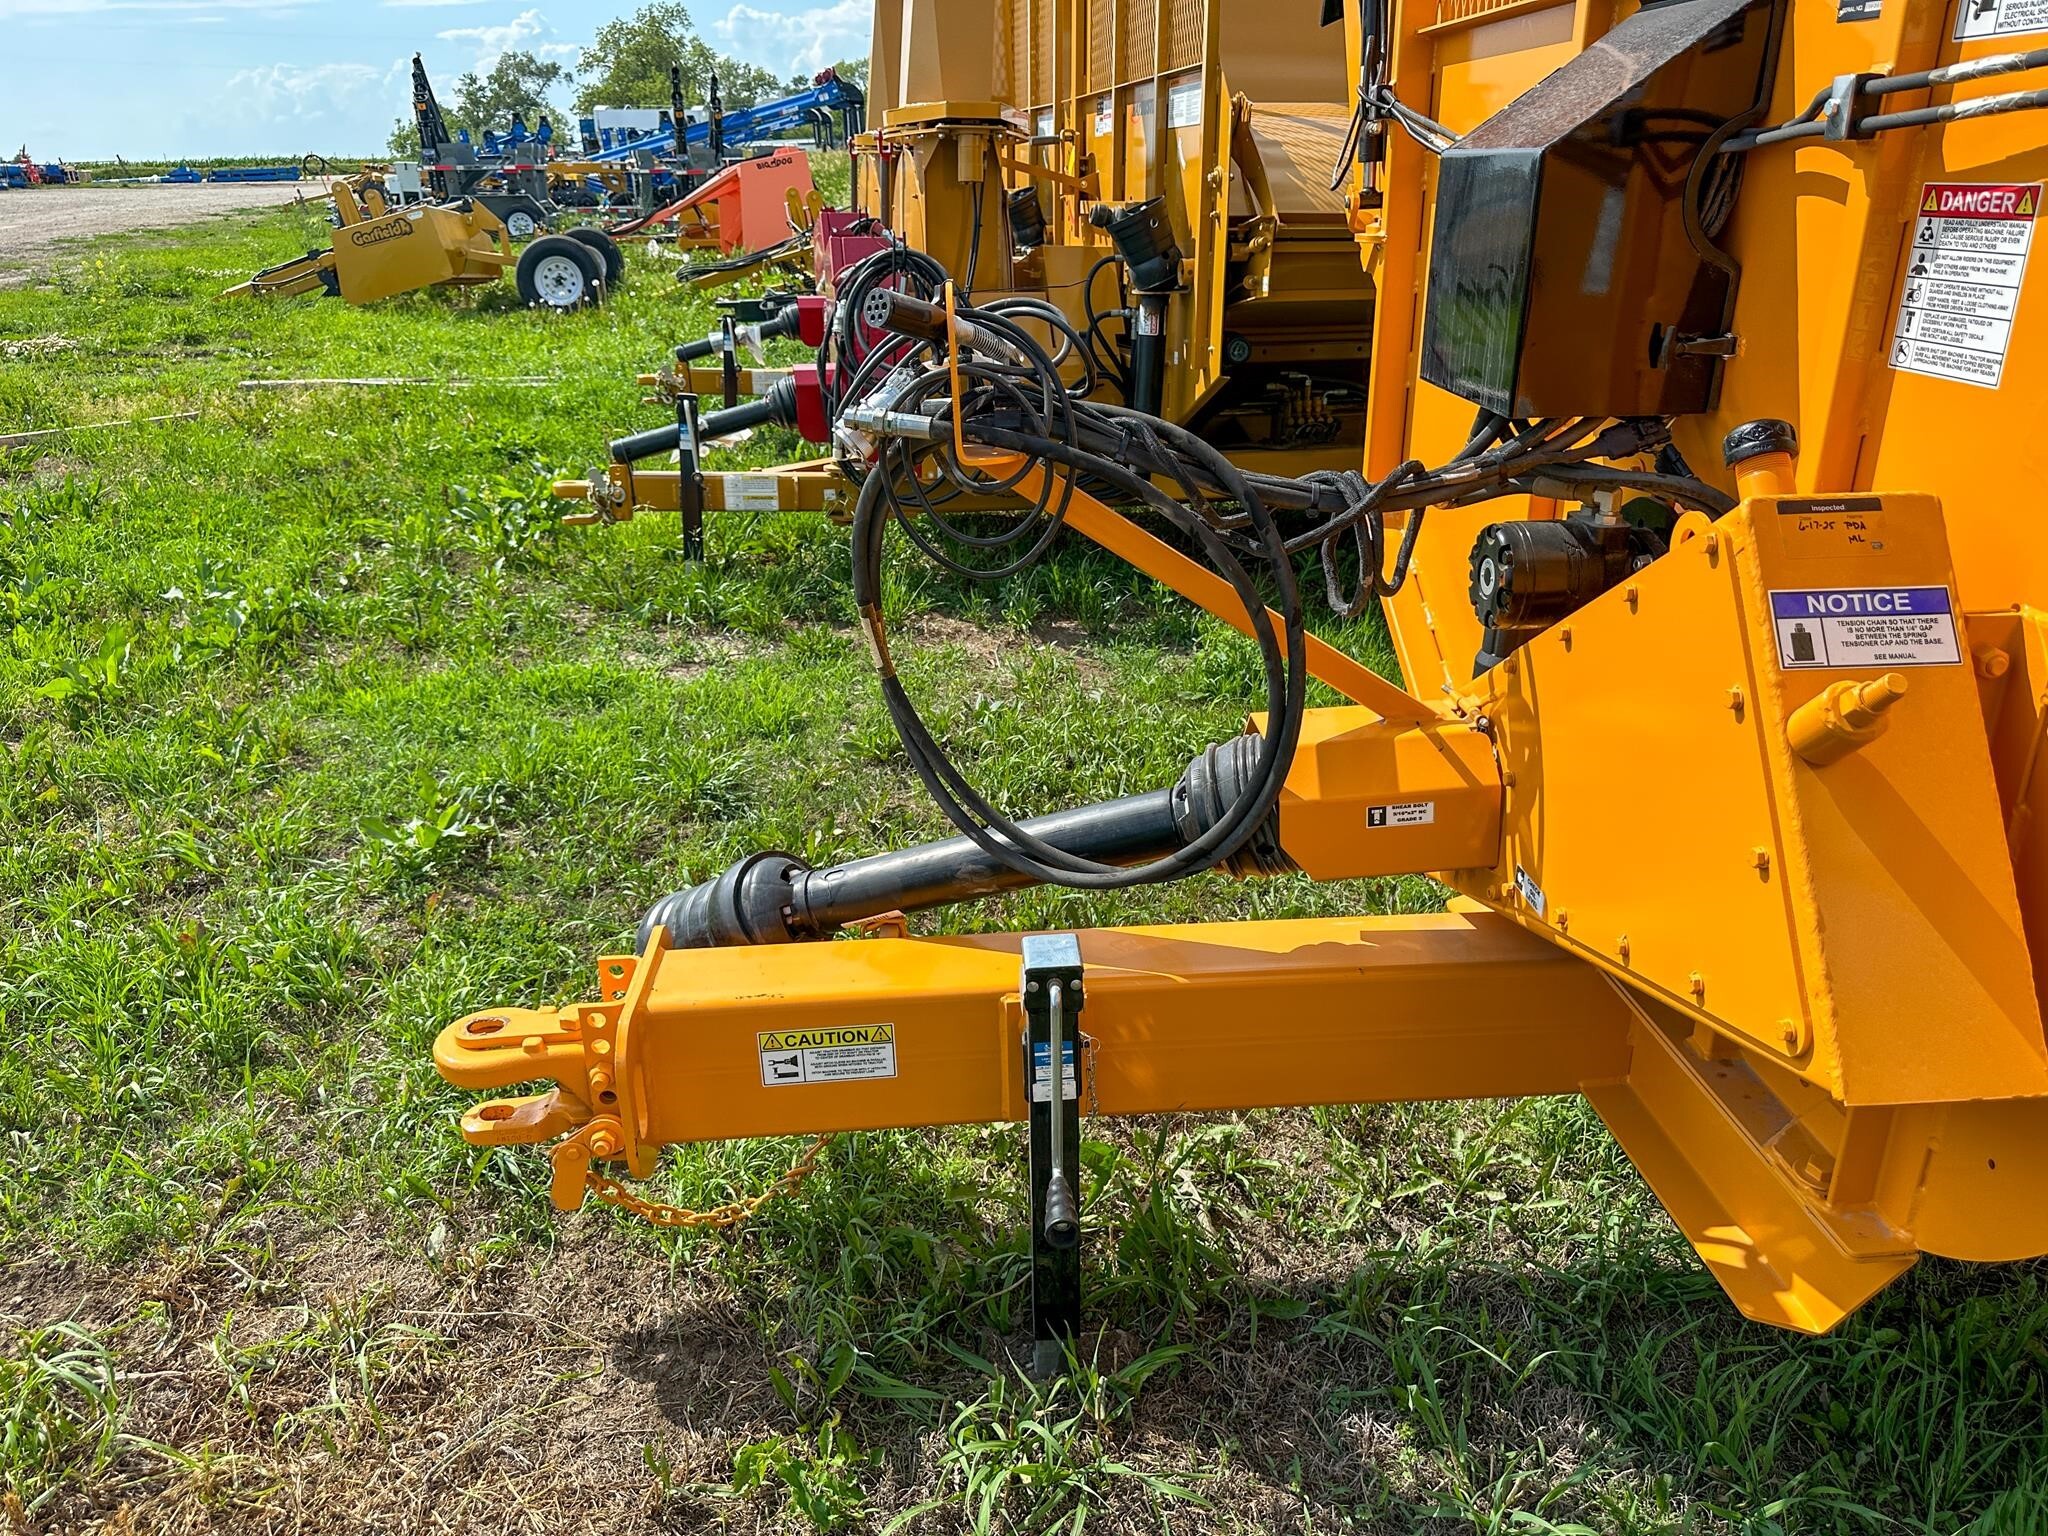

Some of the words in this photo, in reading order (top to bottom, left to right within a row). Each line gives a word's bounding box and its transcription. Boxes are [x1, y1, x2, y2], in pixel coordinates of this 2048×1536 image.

[2005, 1, 2028, 10] SERIOUS
[1998, 20, 2021, 28] WITHOUT
[1940, 191, 2016, 213] DANGER
[352, 220, 402, 246] Garfield
[1798, 521, 1835, 531] 6-17-25
[1848, 534, 1865, 544] ML
[1806, 593, 1911, 613] NOTICE
[785, 1030, 868, 1047] CAUTION
